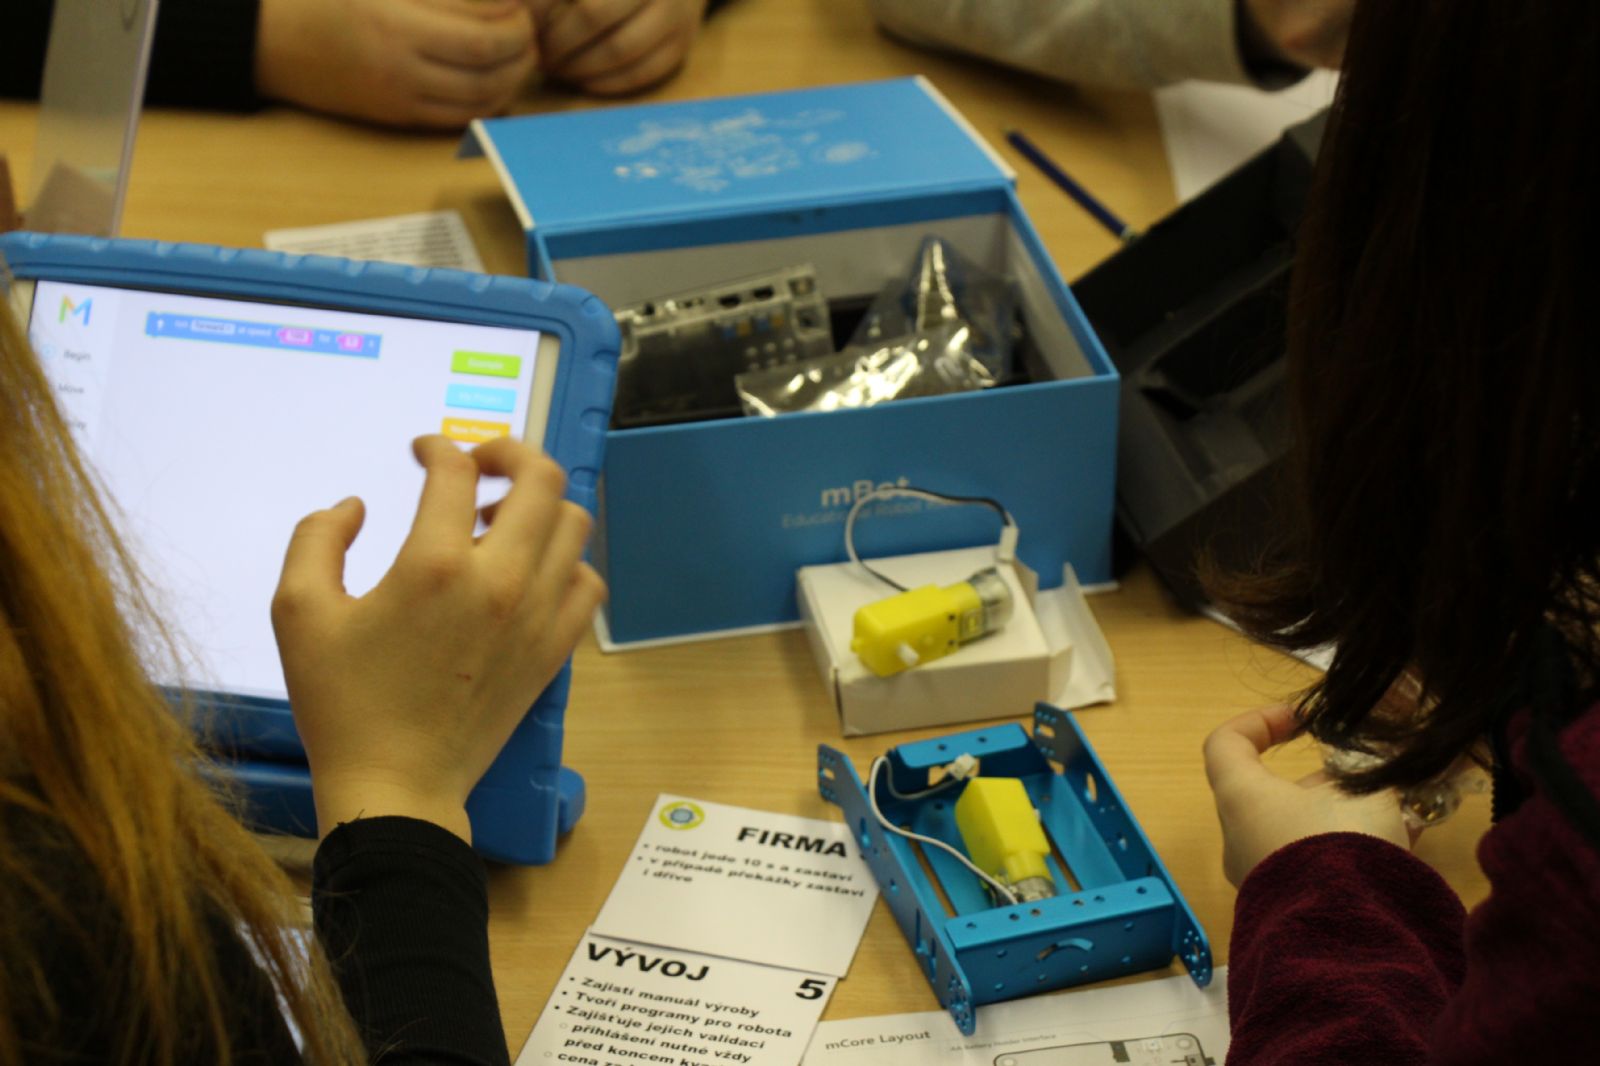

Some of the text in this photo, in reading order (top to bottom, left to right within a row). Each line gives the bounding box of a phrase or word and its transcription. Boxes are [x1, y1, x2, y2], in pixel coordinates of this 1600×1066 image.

[737, 826, 848, 857] FIRMA
[655, 844, 698, 857] robot
[700, 851, 736, 862] jede
[744, 857, 762, 867] 10
[588, 942, 711, 982] VÝVOJ
[795, 978, 827, 1001] 5
[575, 990, 793, 1038] Tvoří programy pro robota
[638, 989, 701, 1008] manuál
[704, 1000, 760, 1018] výroby
[565, 1004, 643, 1029] Zajišťuje
[645, 1021, 694, 1039] jejich
[825, 1030, 931, 1051] mCore Layout
[557, 1052, 599, 1066] cena
[607, 1044, 676, 1065] koncem
